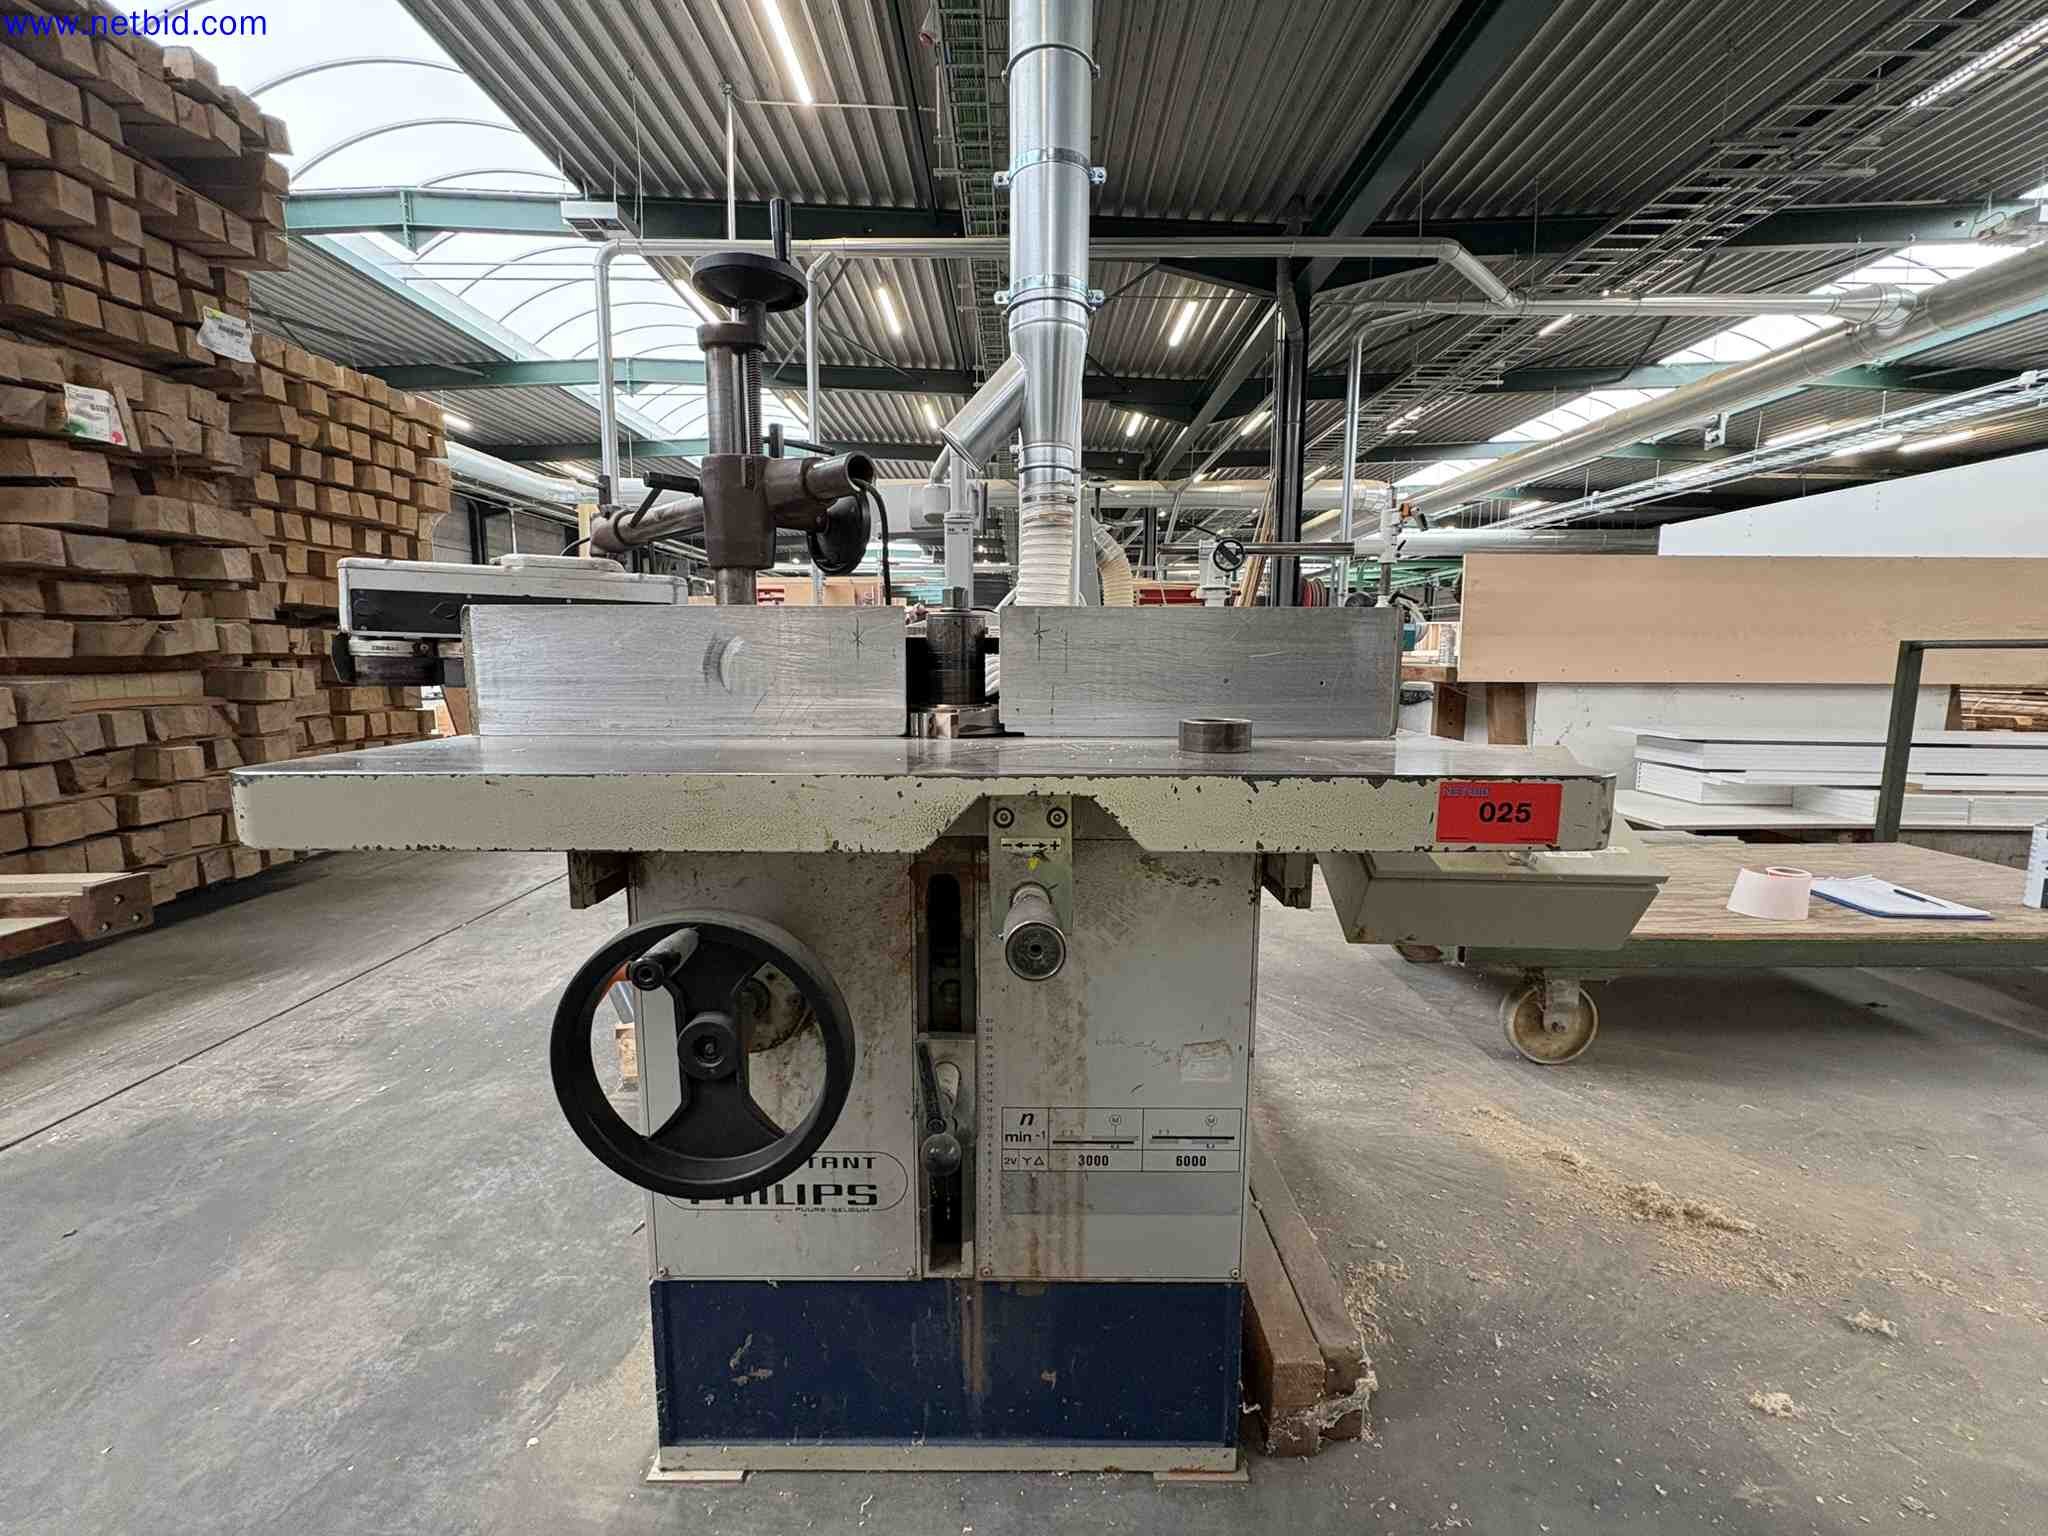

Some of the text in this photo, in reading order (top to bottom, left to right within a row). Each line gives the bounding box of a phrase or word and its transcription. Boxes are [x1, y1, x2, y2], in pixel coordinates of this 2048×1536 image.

[1479, 801, 1532, 823] 025
[1078, 1154, 1110, 1167] 3000
[1176, 1155, 1207, 1167] 6000
